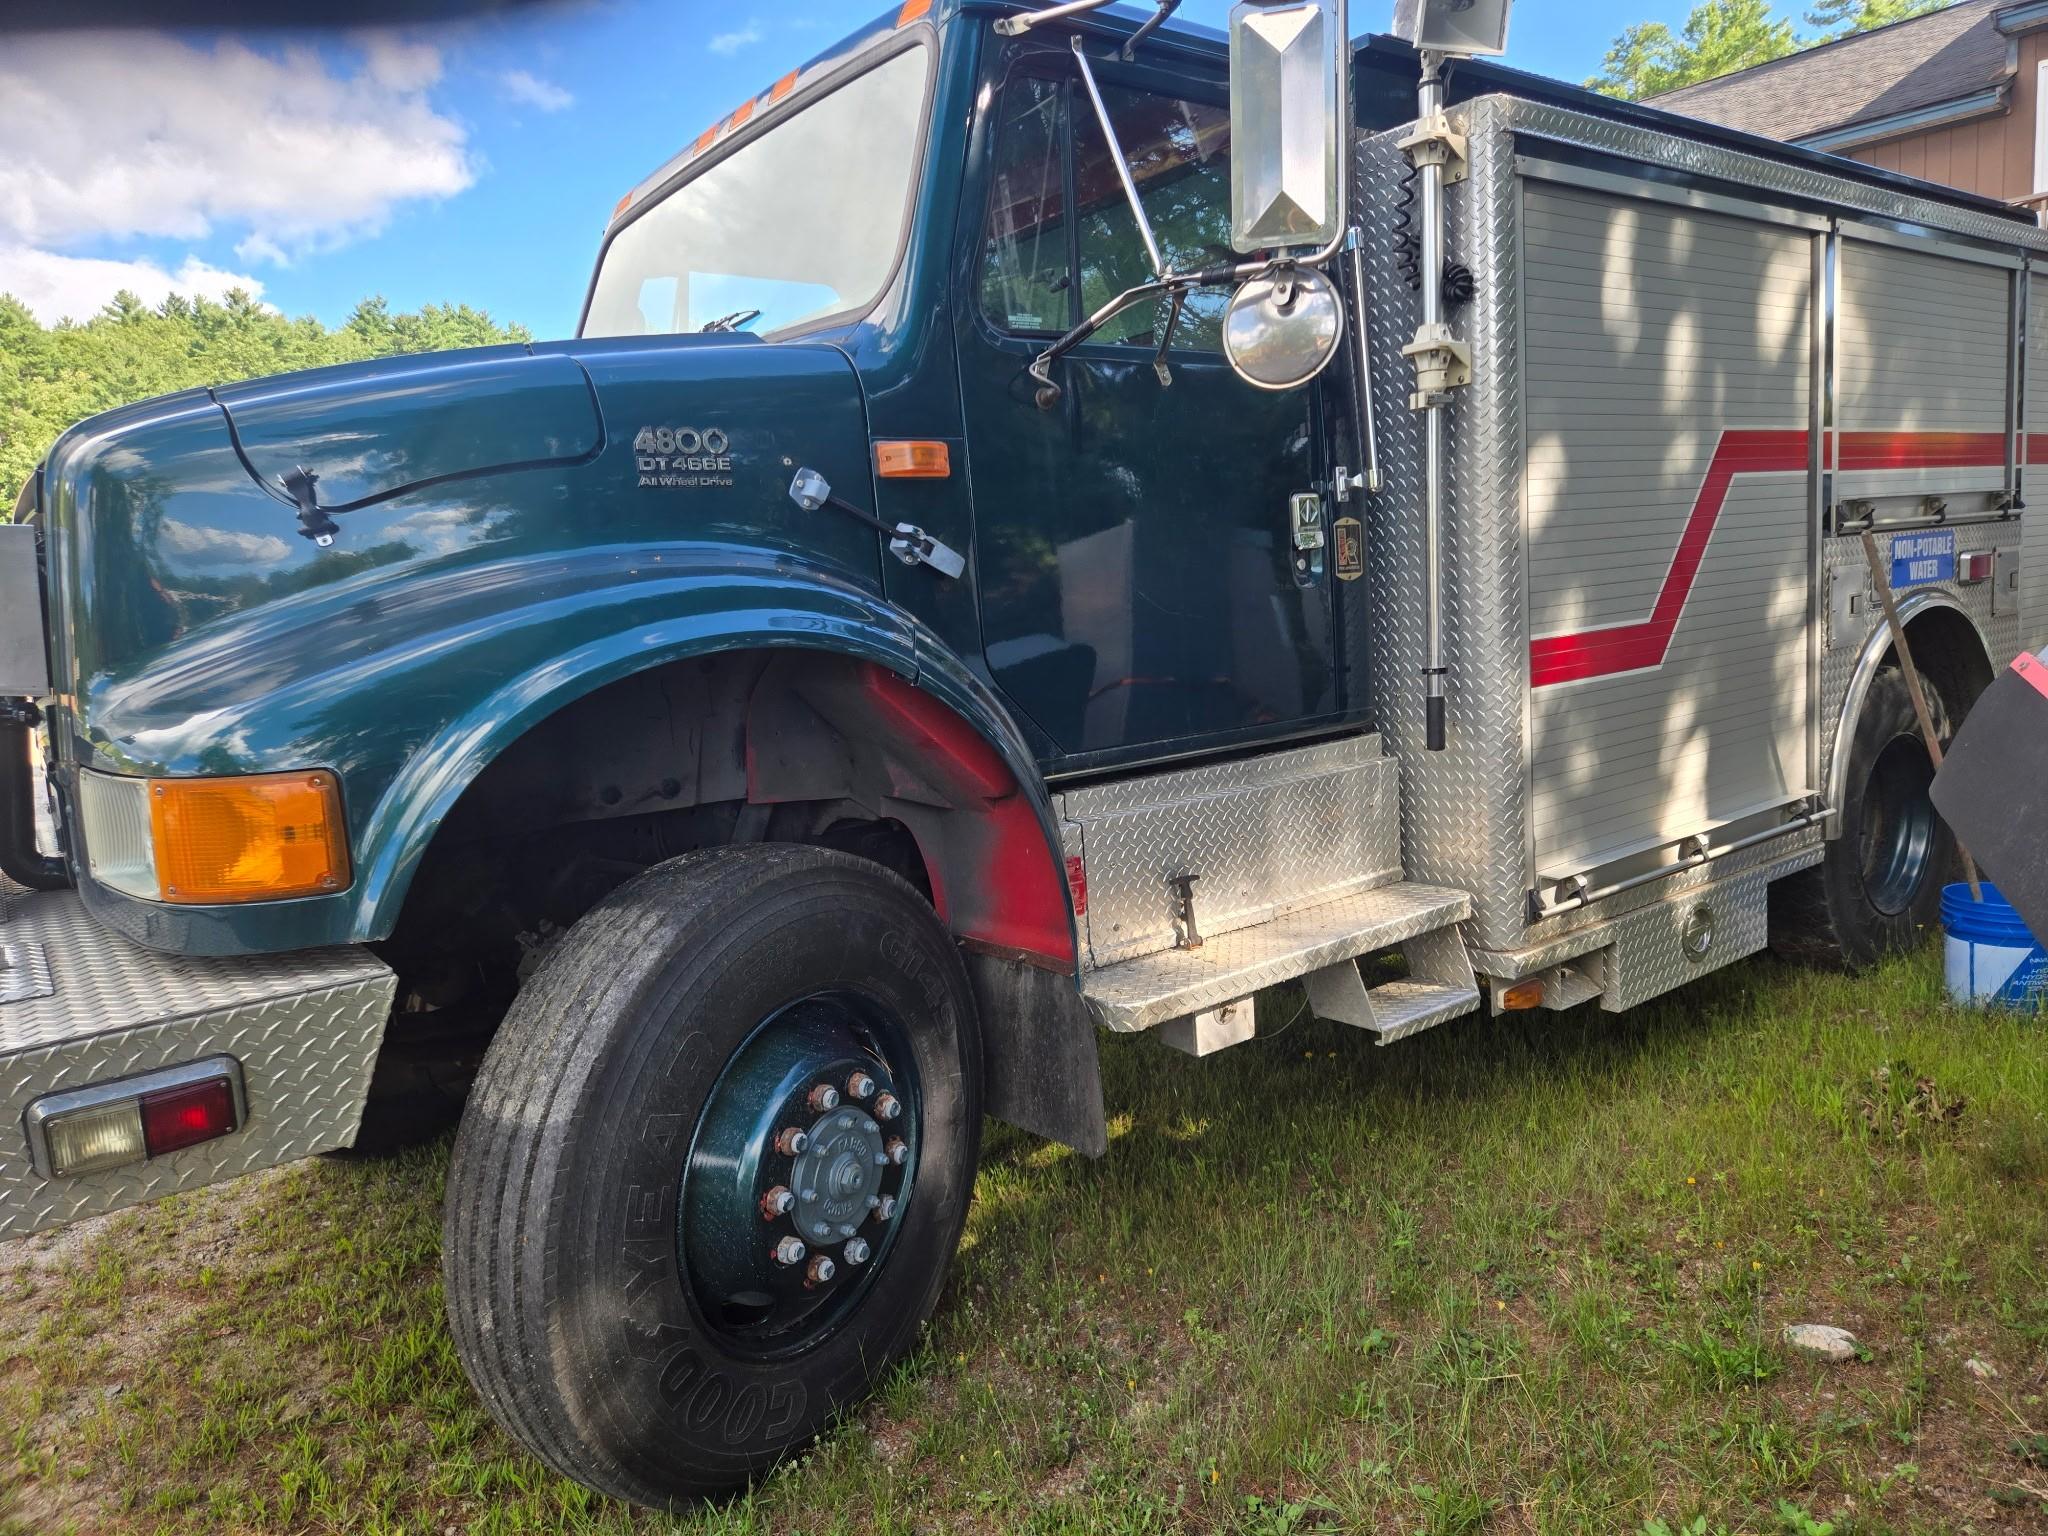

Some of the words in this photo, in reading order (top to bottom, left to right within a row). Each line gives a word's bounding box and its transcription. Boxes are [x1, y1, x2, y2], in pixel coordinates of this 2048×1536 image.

[634, 427, 729, 454] 4800
[638, 457, 669, 471] DT
[672, 457, 731, 471] 466E
[639, 475, 658, 486] All
[659, 475, 698, 486] Wheel
[700, 475, 733, 486] Drive
[1894, 535, 1952, 560] NON-POTABLE
[1909, 559, 1938, 580] WATER
